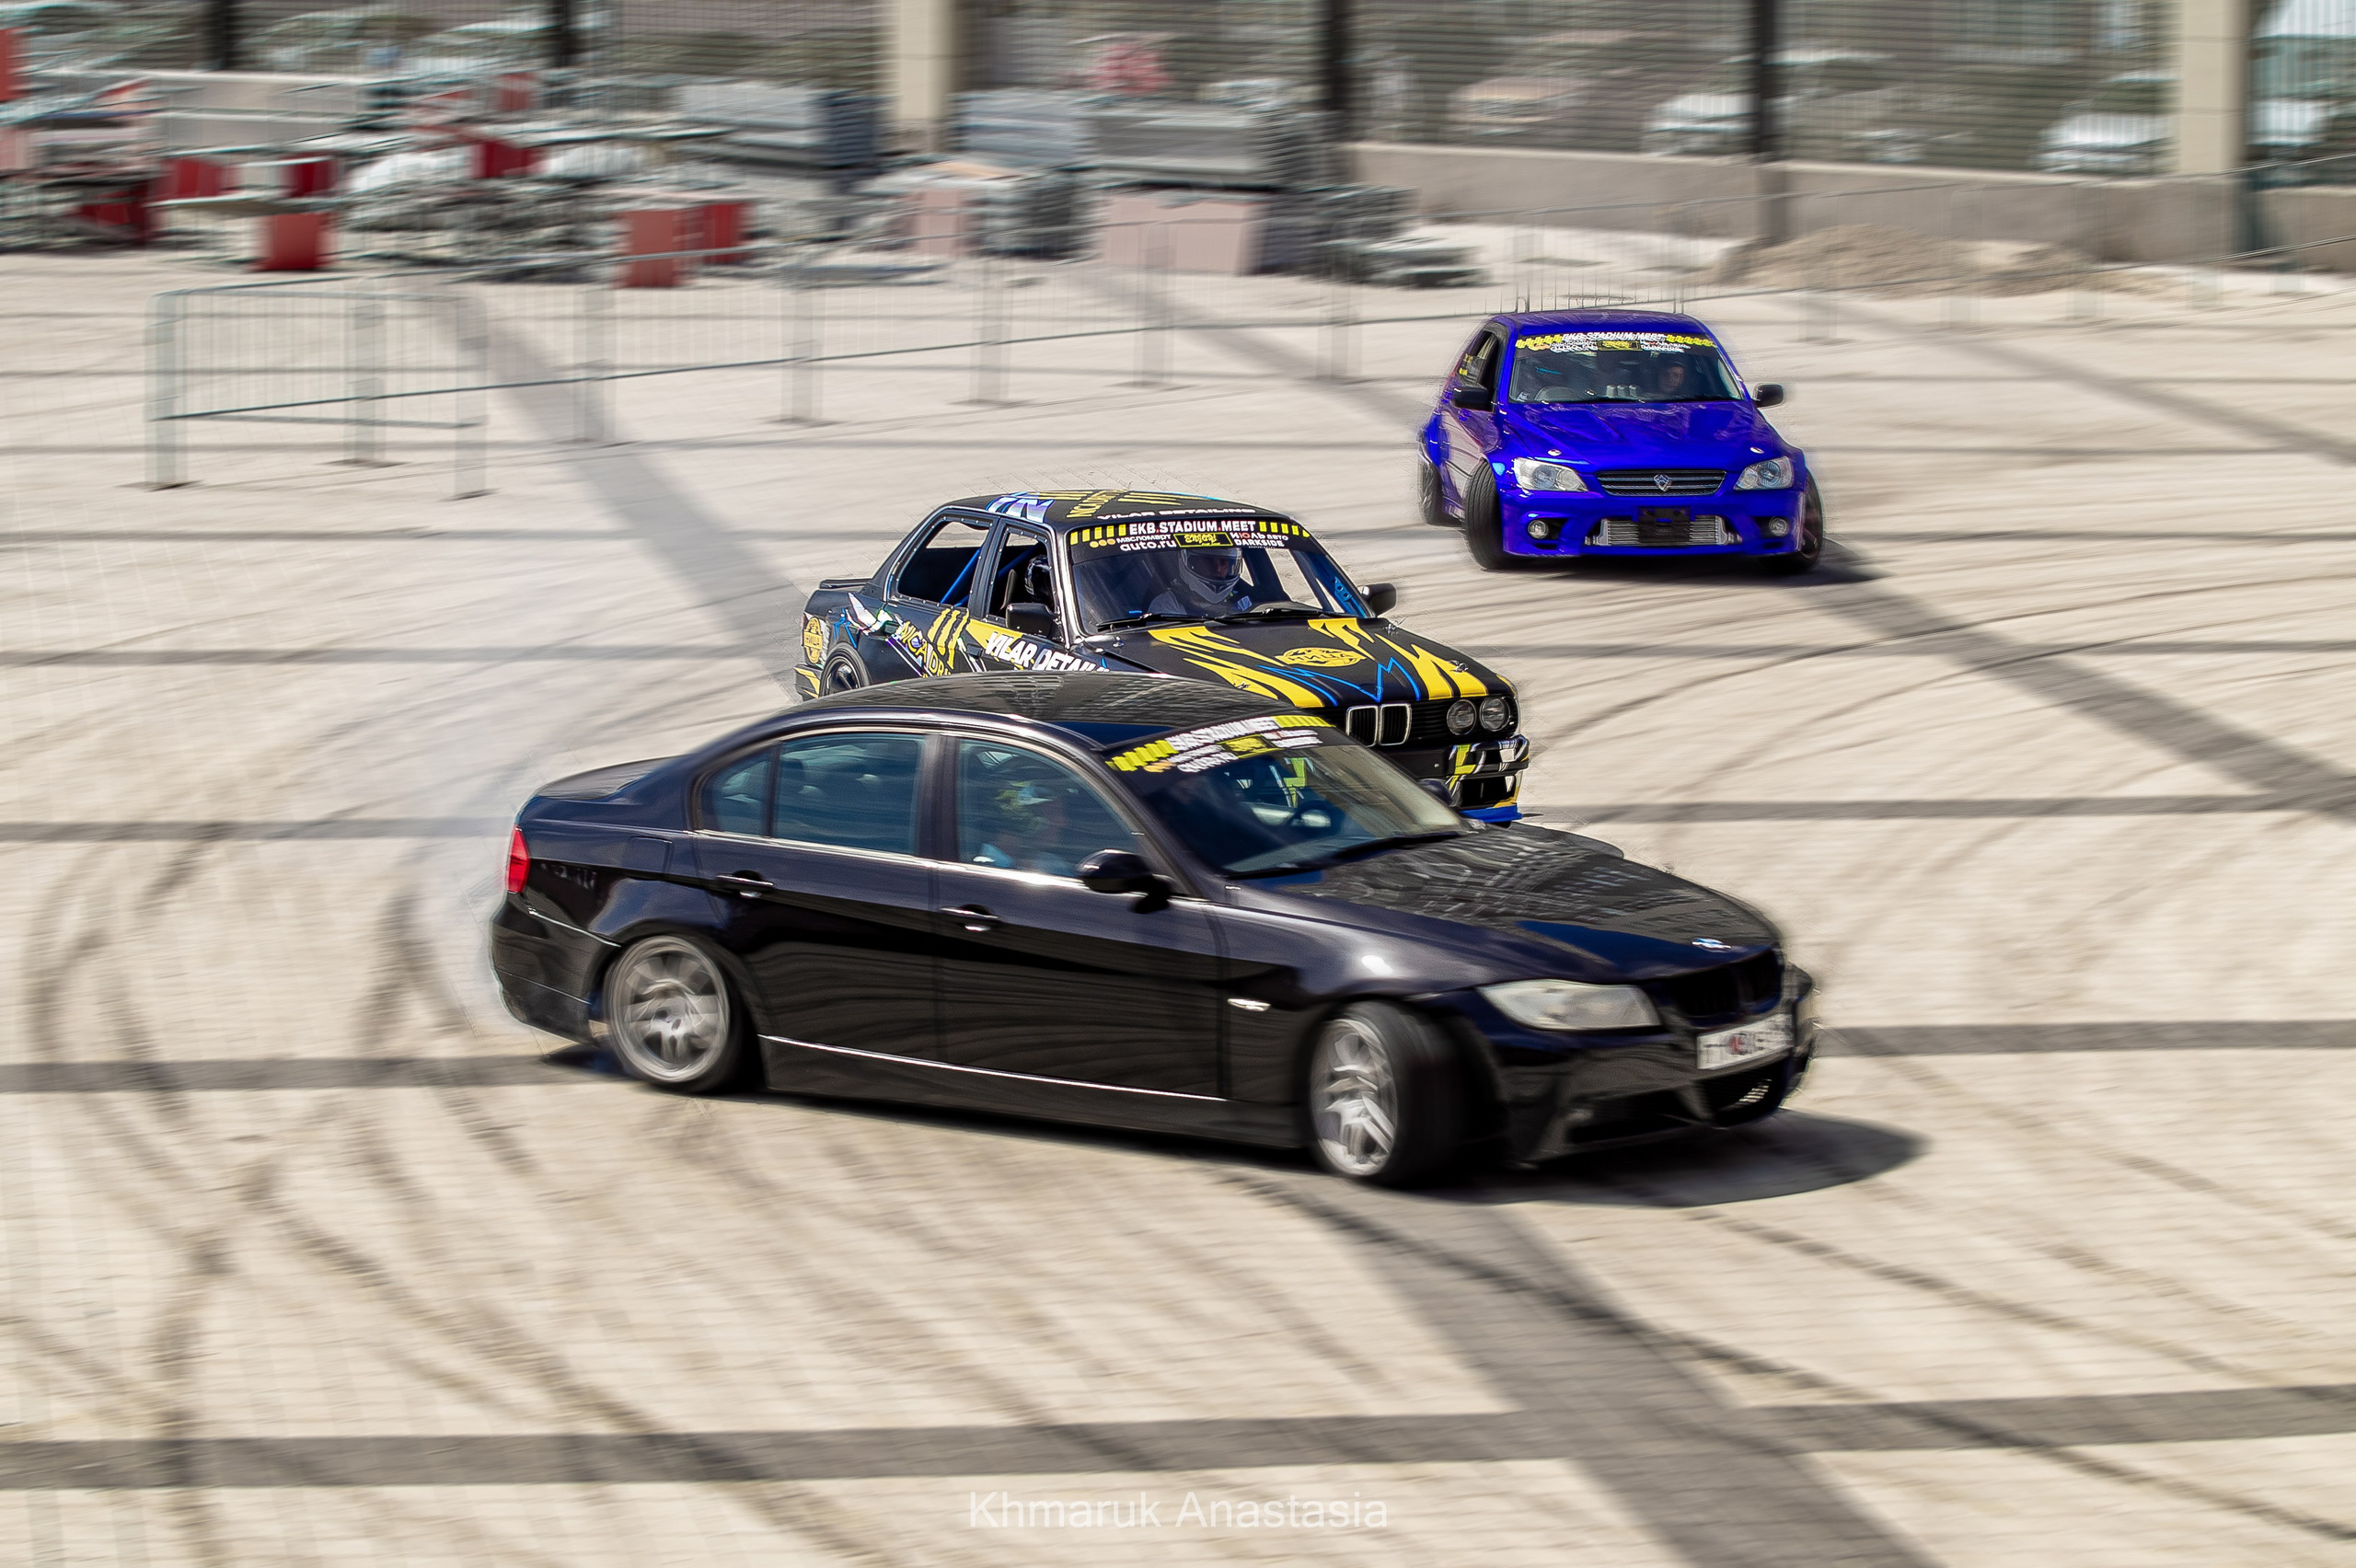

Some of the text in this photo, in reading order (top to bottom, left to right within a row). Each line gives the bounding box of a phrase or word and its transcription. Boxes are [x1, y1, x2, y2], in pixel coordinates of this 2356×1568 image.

[1129, 521, 1256, 535] EKB.STADIUM.MEET
[1120, 540, 1177, 551] auto.ru
[1233, 539, 1285, 548] DARKSIDE
[985, 631, 1038, 667] VILAR
